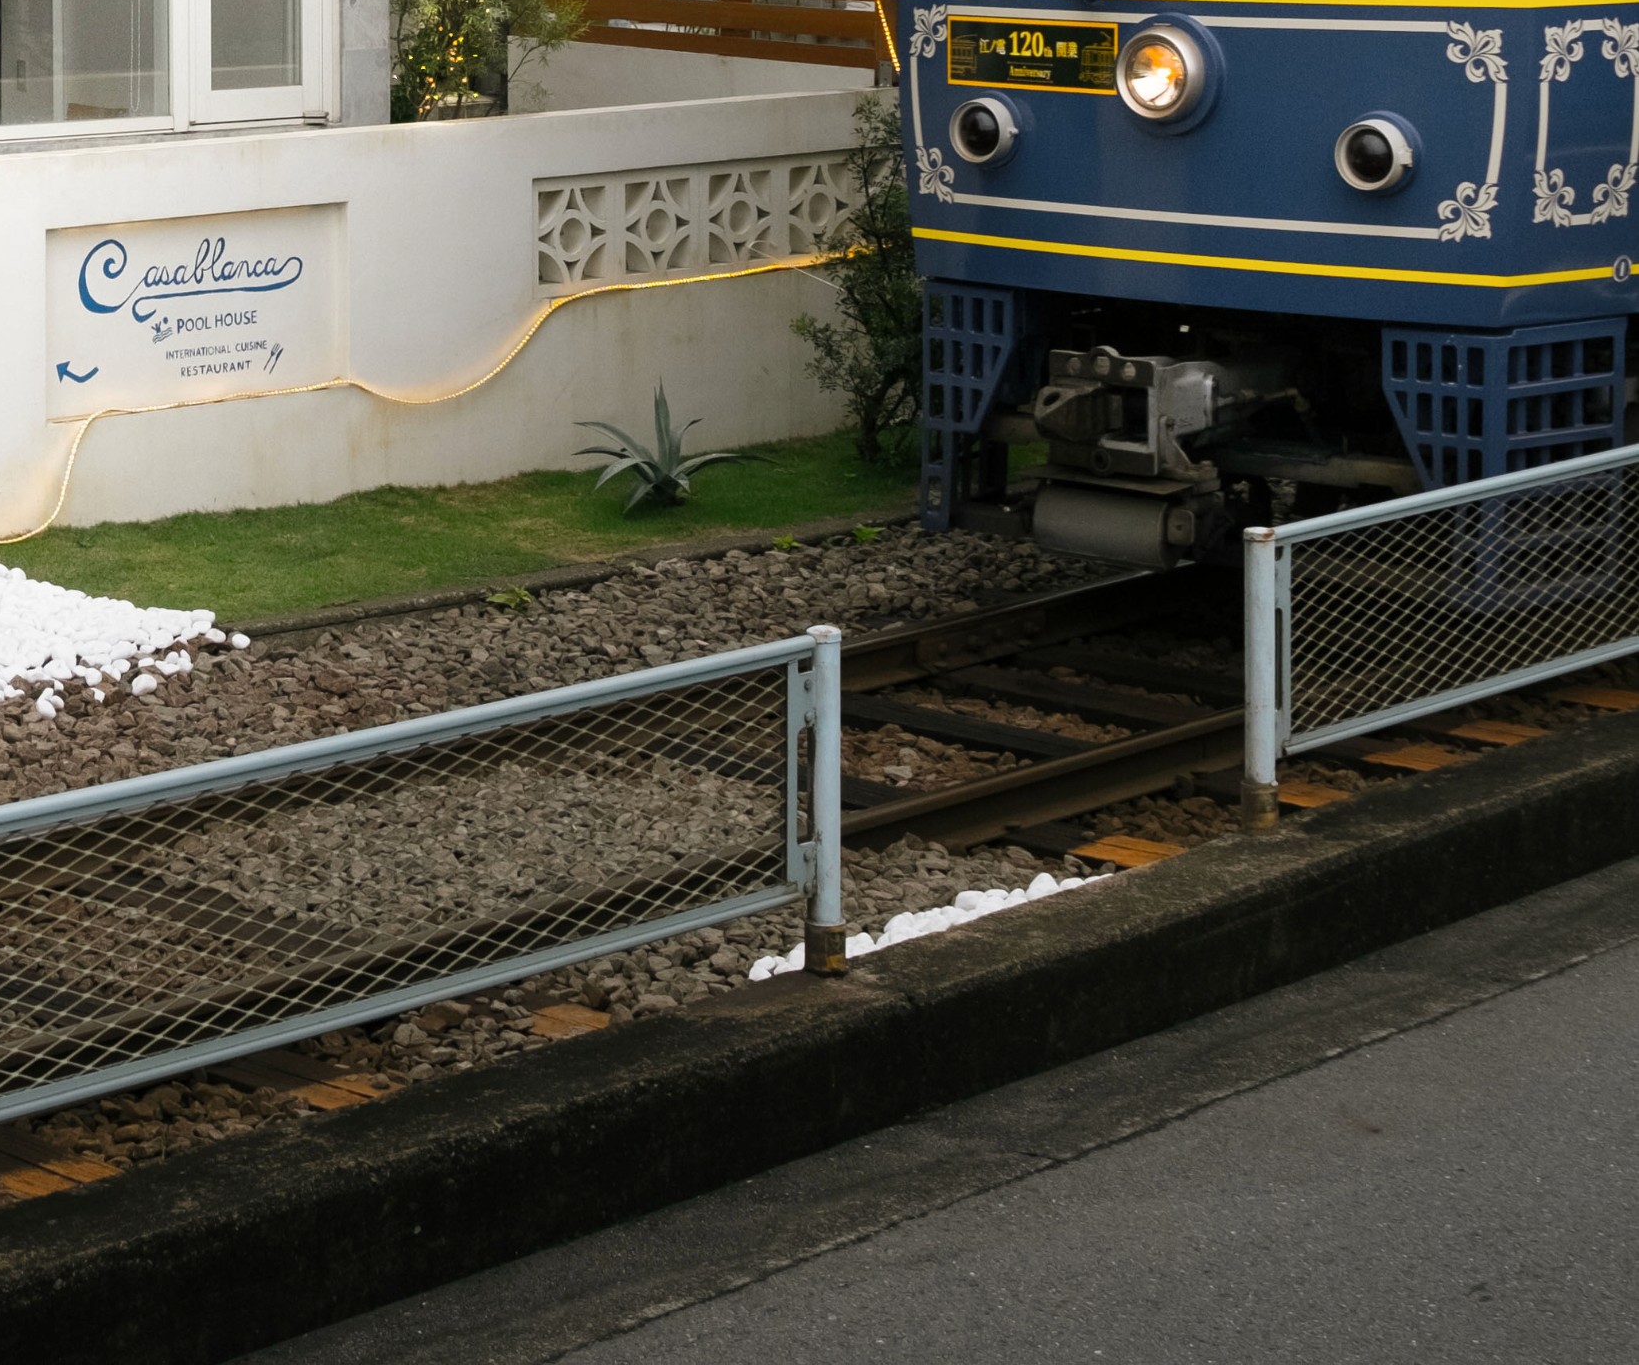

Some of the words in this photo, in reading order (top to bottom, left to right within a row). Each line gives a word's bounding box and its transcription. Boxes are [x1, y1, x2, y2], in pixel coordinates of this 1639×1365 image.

[1009, 65, 1052, 81] Anniversary
[78, 237, 303, 323] Casablanca
[176, 316, 212, 334] POOL
[214, 310, 258, 328] HOUSE
[165, 344, 231, 360] INTERNATIONAL
[234, 340, 268, 353] CUISINE
[180, 360, 253, 377] RESTAURANT
